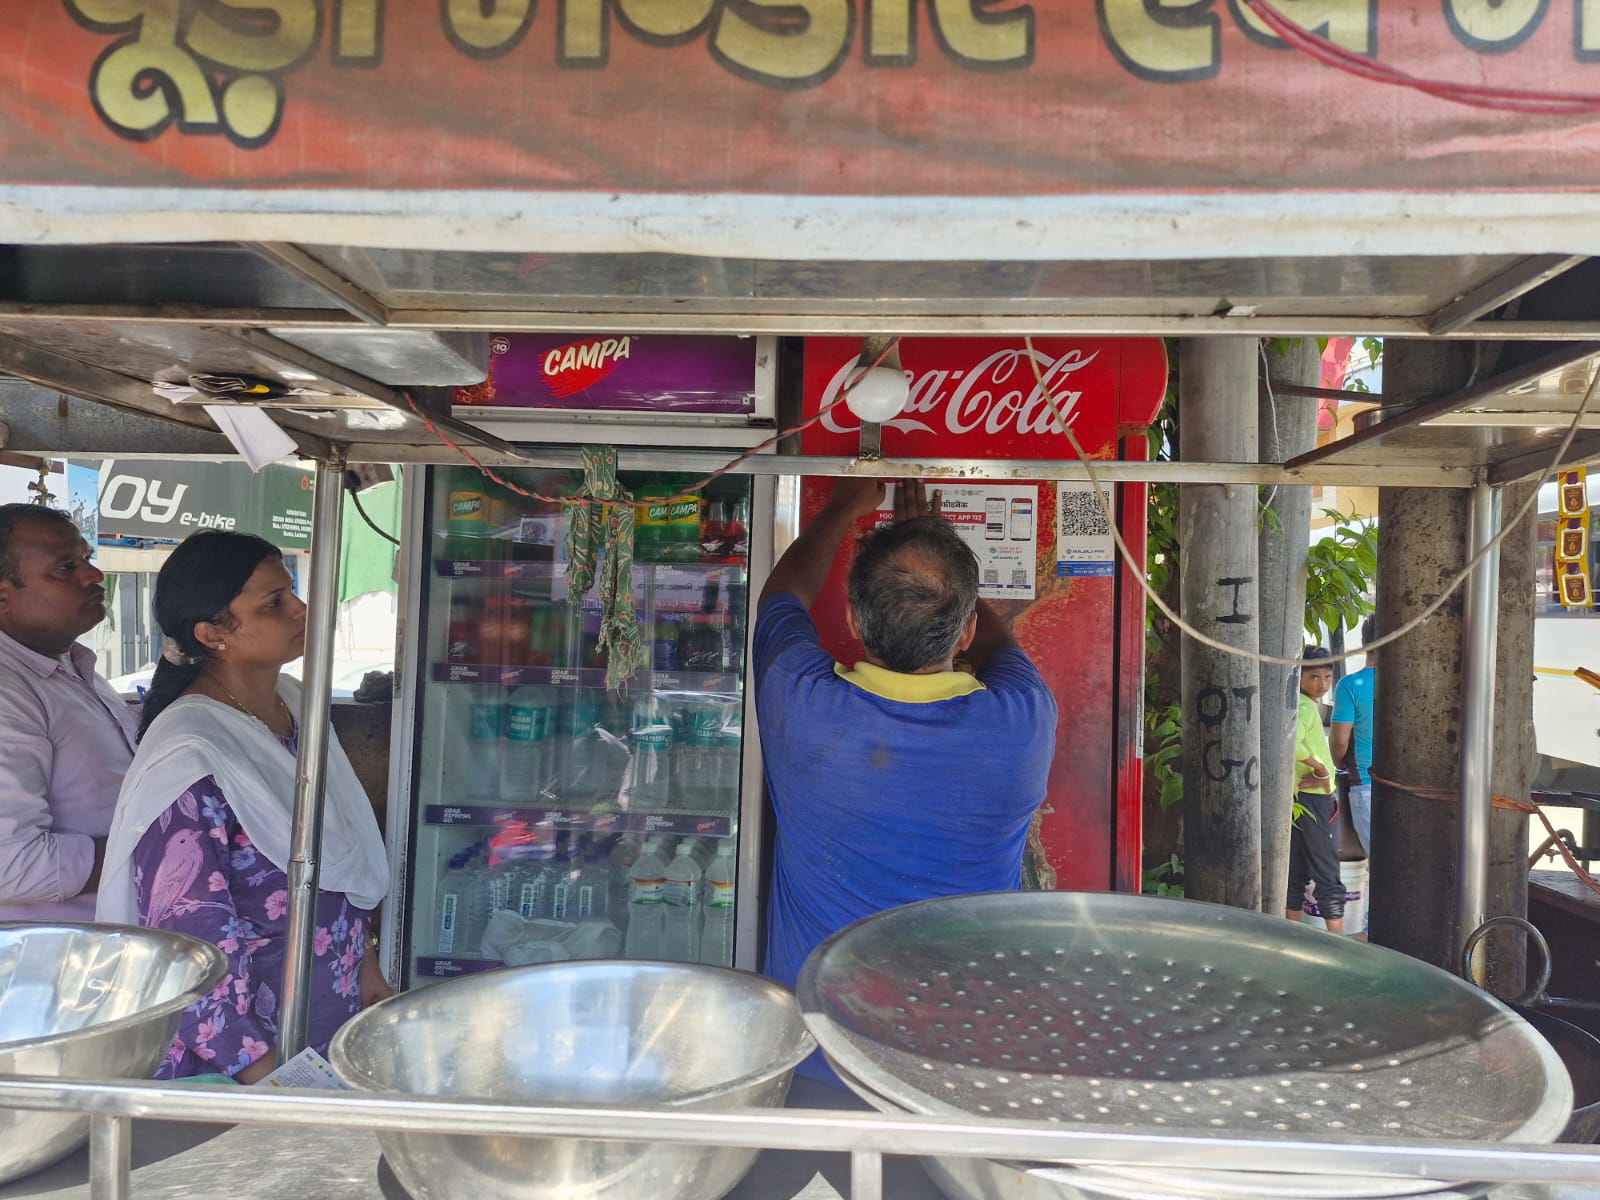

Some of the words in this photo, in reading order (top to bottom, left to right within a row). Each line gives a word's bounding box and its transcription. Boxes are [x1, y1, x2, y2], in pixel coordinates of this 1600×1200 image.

[544, 336, 630, 376] CAMPA
[819, 349, 1101, 435] Ca-Cola
[649, 505, 667, 517] CAM
[670, 502, 697, 515] CAMPA
[180, 511, 236, 530] e-bike
